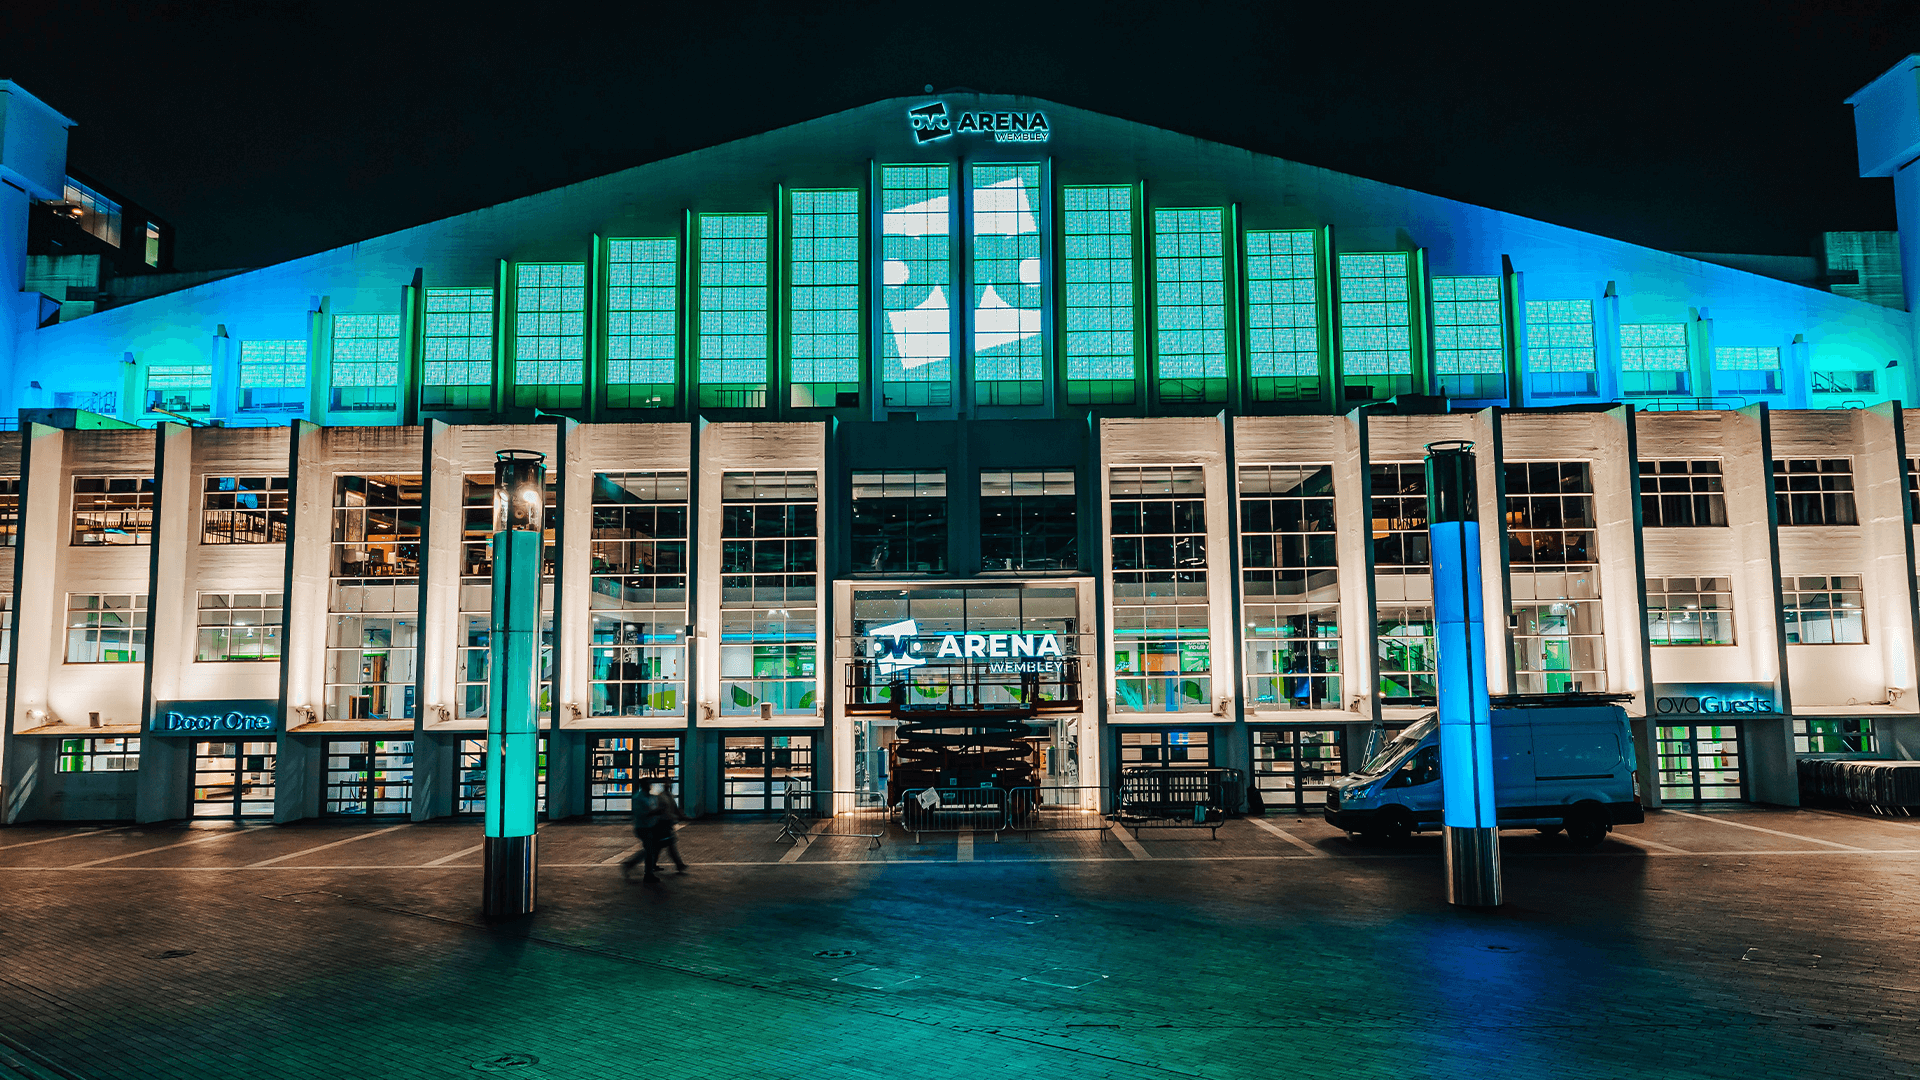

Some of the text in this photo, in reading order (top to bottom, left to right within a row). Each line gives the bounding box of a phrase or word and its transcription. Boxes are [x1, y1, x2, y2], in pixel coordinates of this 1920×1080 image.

[958, 112, 1049, 131] ARENA
[996, 132, 1049, 141] WEMBLEY
[937, 634, 1063, 658] ARENA
[990, 661, 1063, 673] WEMBLEY
[164, 711, 271, 731] Door One
